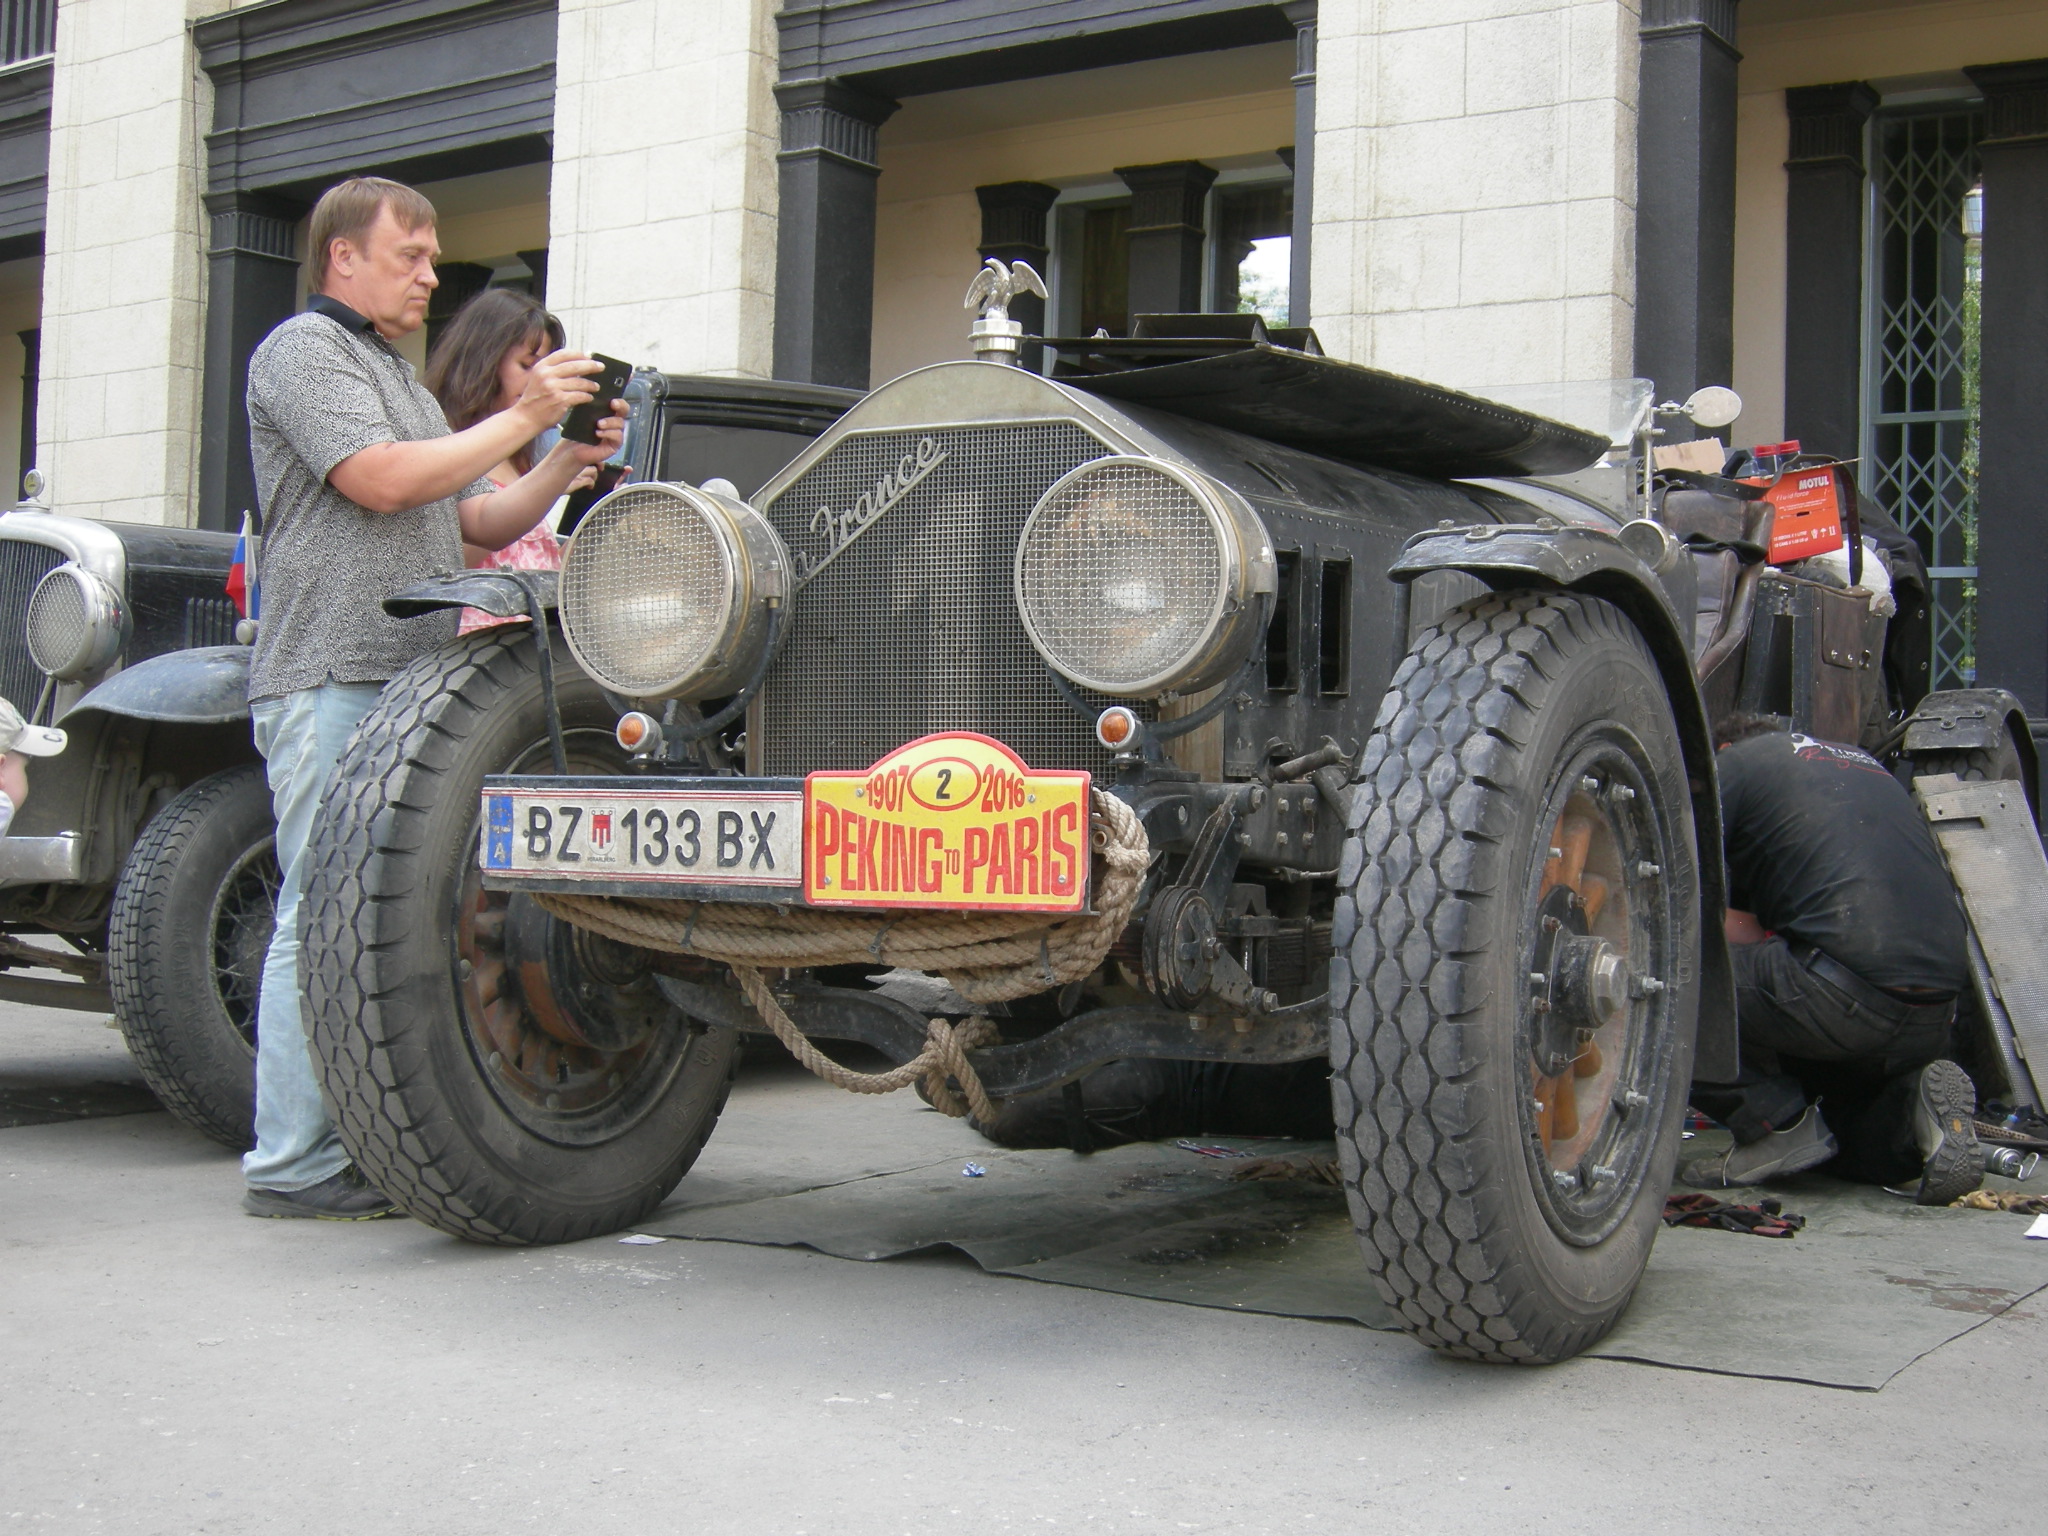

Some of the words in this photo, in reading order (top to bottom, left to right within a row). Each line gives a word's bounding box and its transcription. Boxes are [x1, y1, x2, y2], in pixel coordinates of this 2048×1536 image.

[810, 437, 941, 551] France
[1799, 475, 1829, 490] MOTUL
[866, 765, 910, 812] 1907
[936, 769, 951, 799] 2
[981, 763, 1025, 812] 2016
[494, 842, 505, 861] A
[528, 806, 583, 861] BZ
[621, 808, 701, 866] 133
[717, 811, 776, 869] BX
[816, 799, 943, 893] PEKING
[944, 848, 960, 876] TO
[963, 801, 1077, 896] PARIS
